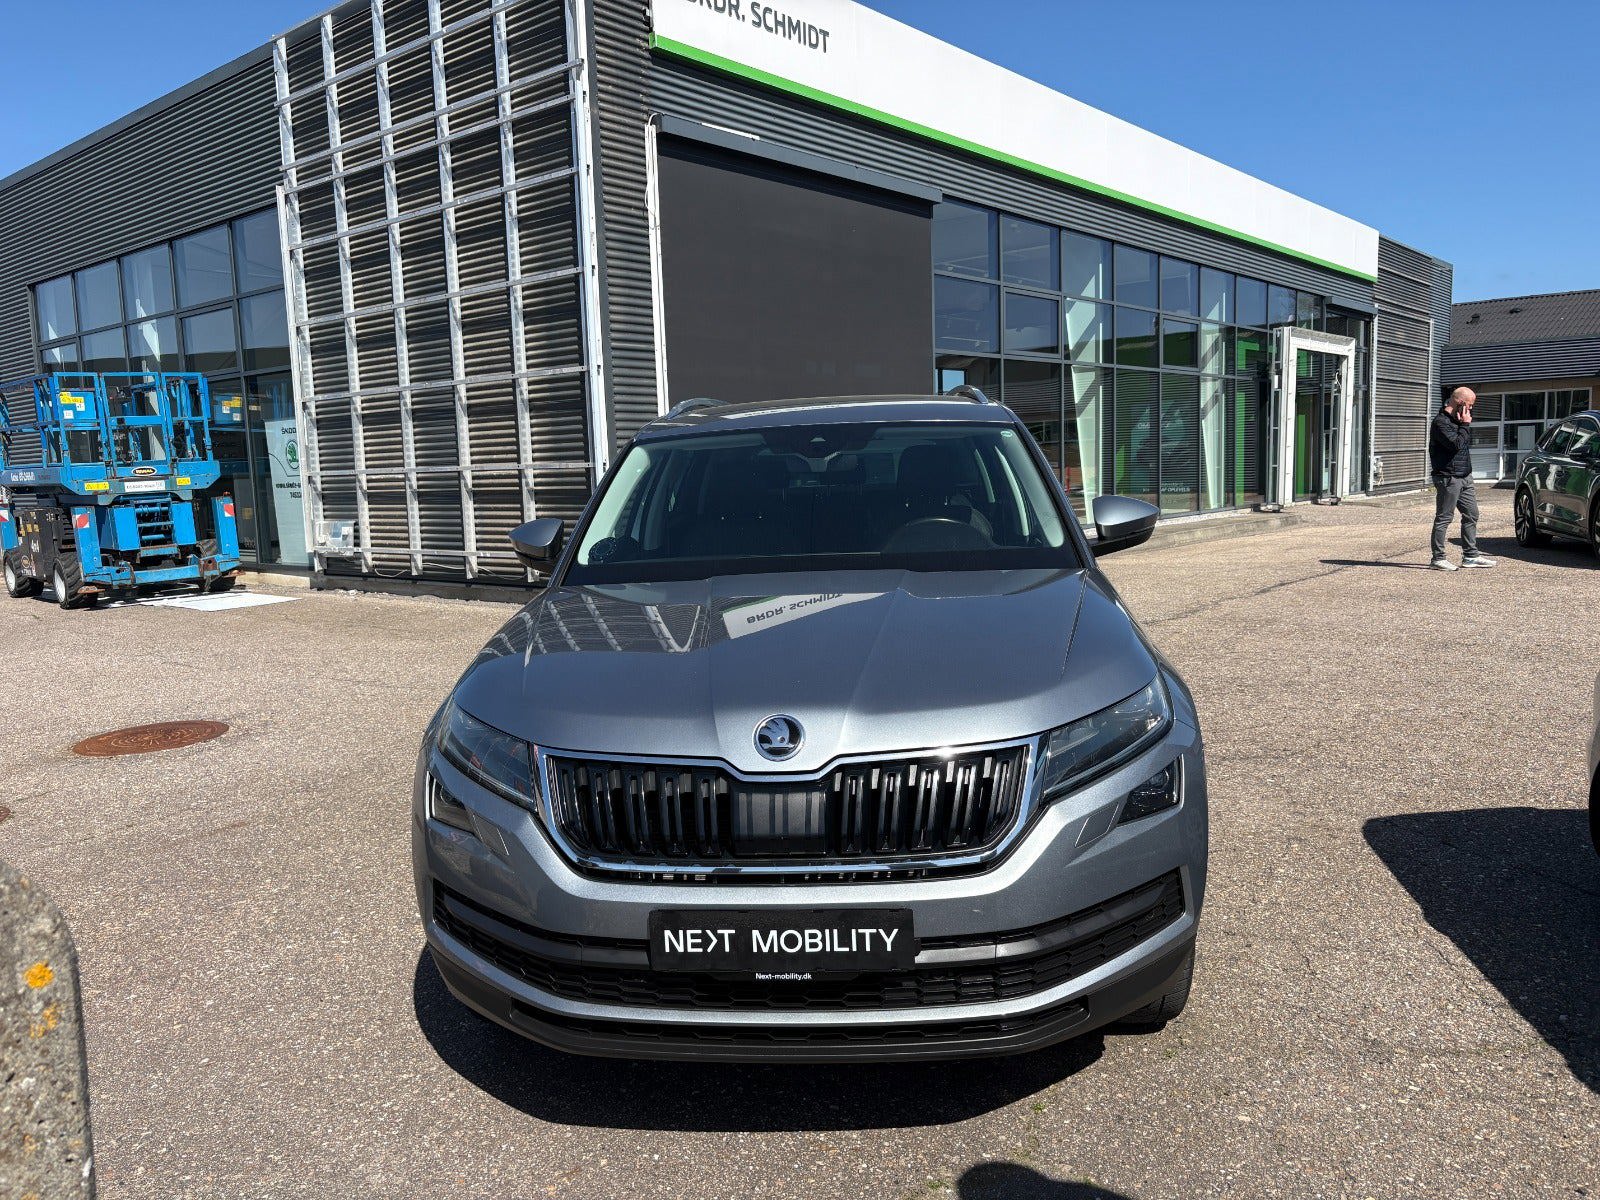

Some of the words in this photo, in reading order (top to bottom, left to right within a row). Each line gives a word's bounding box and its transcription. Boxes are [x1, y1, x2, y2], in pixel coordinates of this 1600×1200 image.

[687, 0, 746, 23] DR.
[750, 1, 830, 53] SCHMIDT
[281, 427, 297, 435] ŠKOD
[751, 928, 899, 953] MOBILITY
[755, 972, 813, 982] Next-mobility.dk
